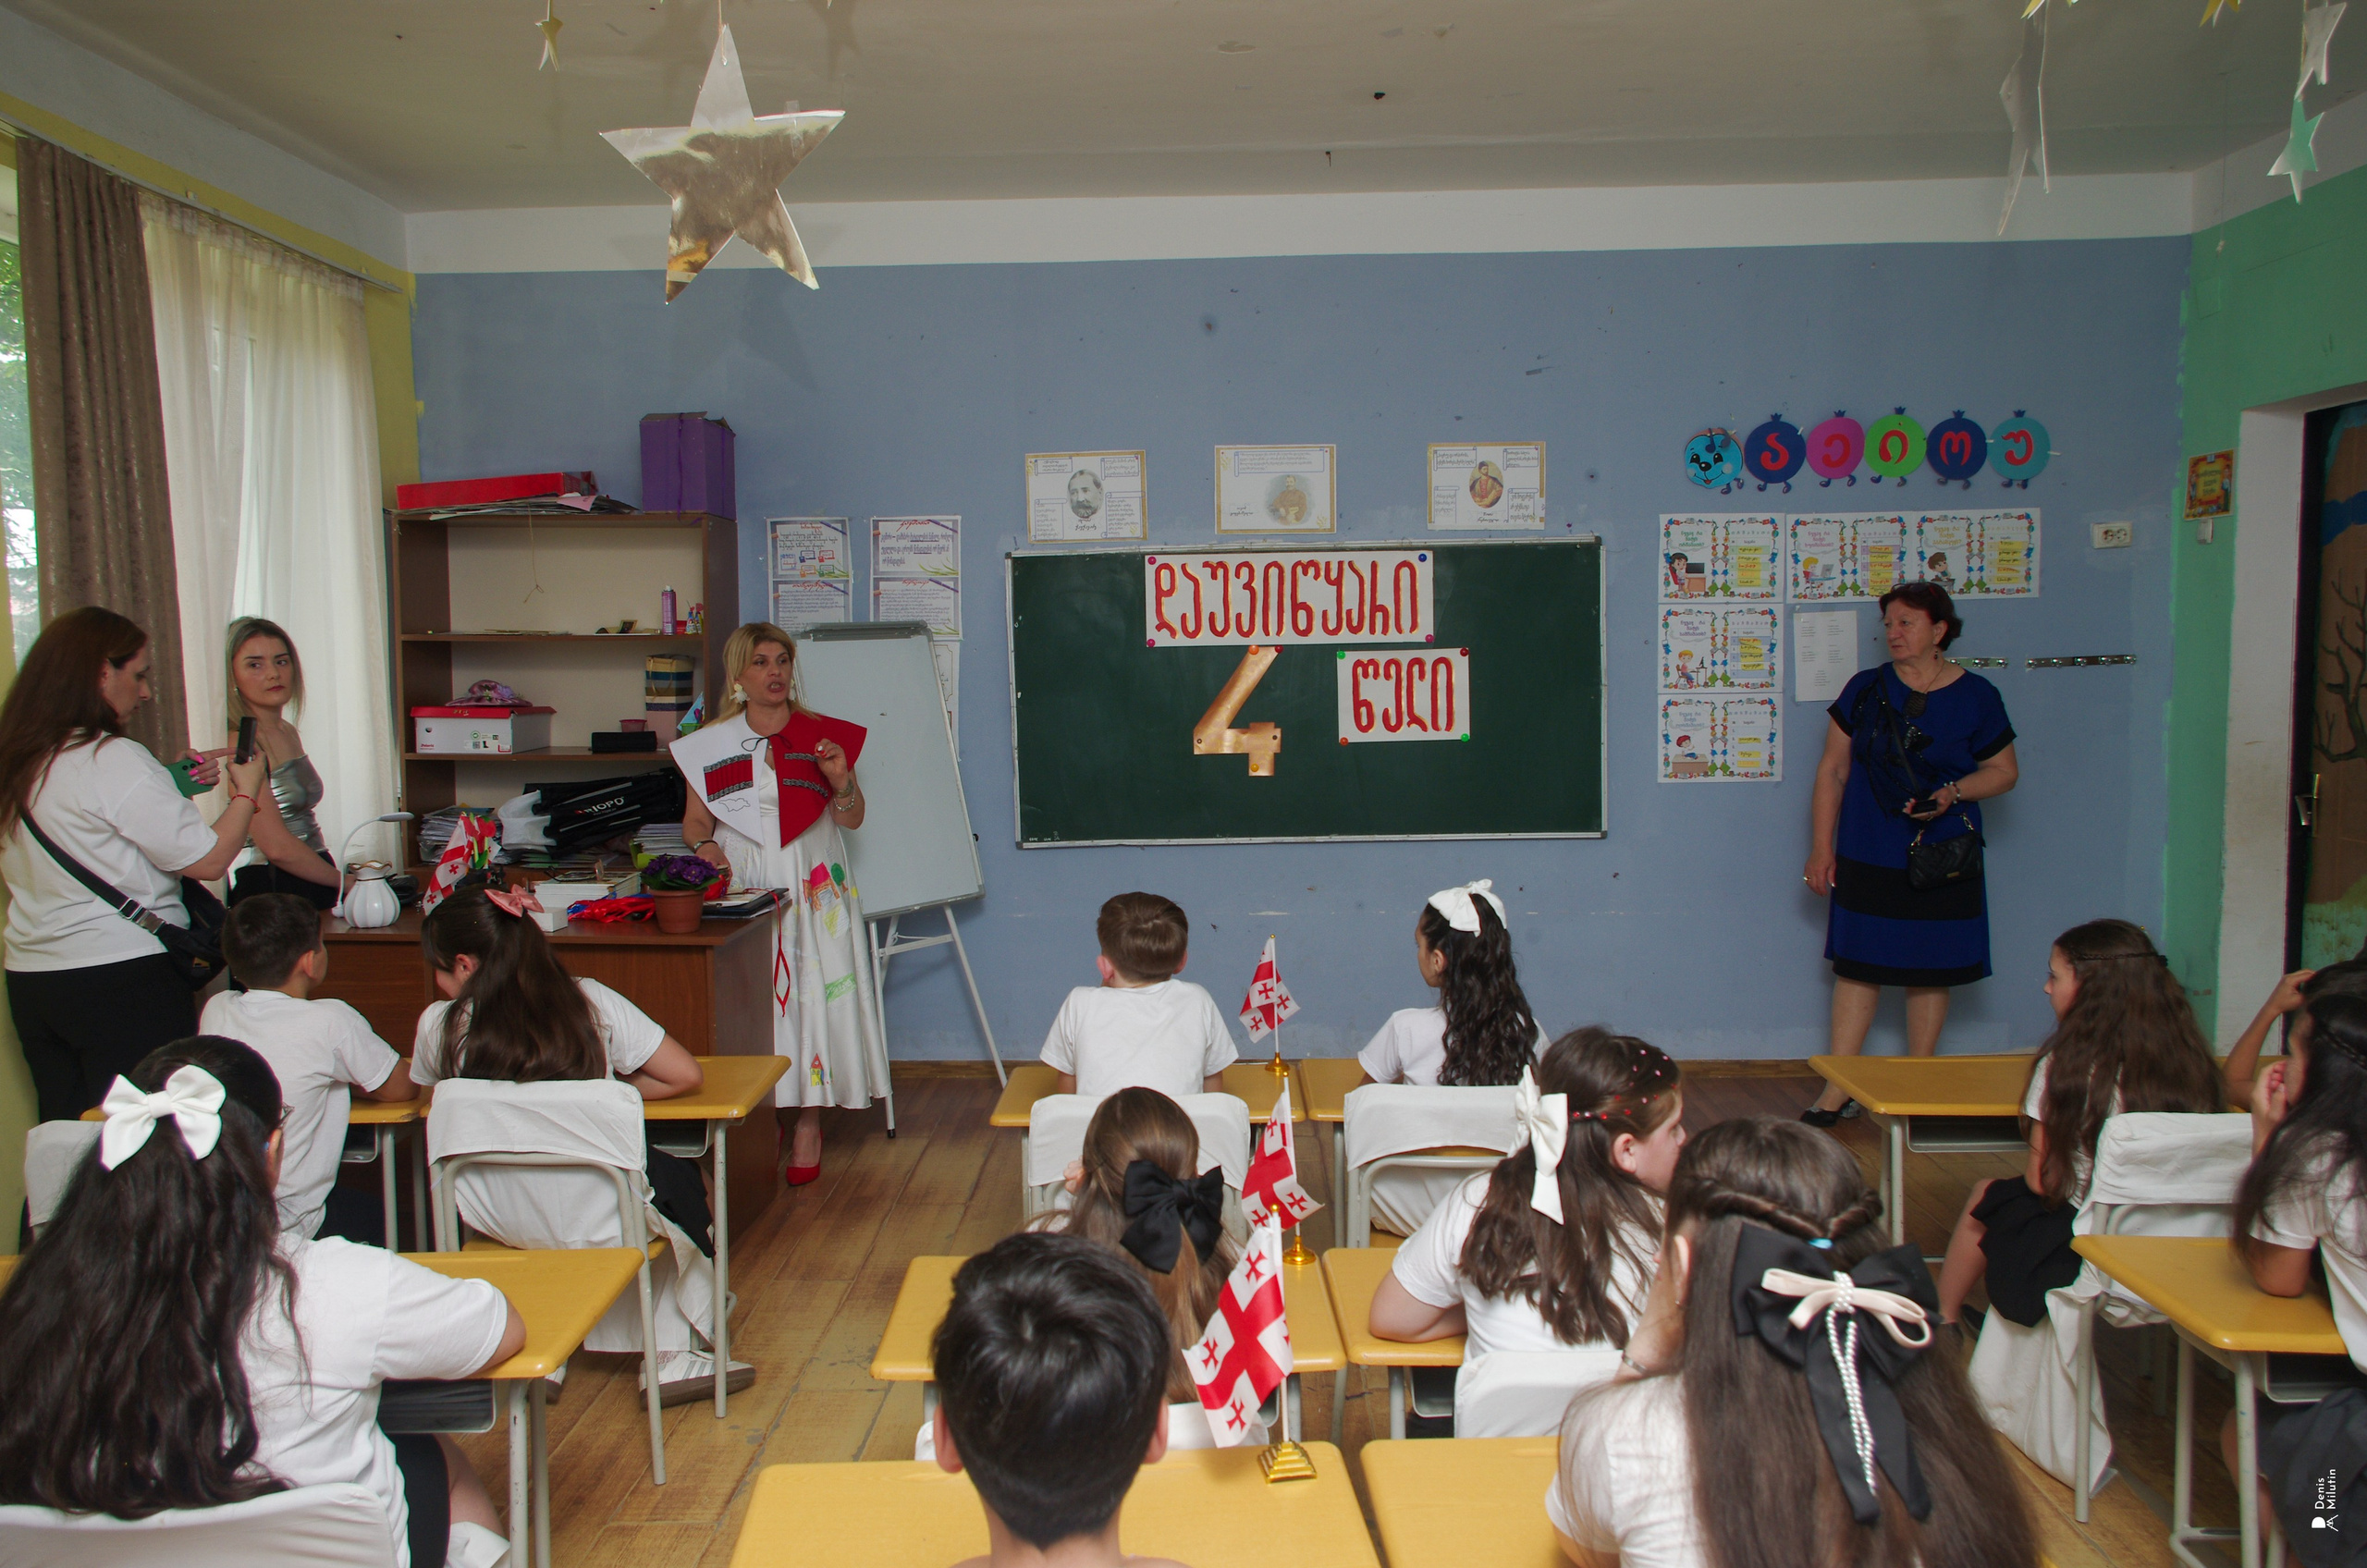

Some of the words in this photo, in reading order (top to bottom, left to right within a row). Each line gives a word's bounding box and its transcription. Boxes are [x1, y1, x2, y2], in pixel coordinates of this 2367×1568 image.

[1760, 433, 1789, 470] ა
[1821, 433, 1850, 468] ე
[1878, 429, 1909, 465] ი
[1939, 430, 1971, 466] ო
[2001, 429, 2033, 467] უ
[1154, 558, 1422, 640] დაუვიწყარი
[1193, 644, 1282, 777] 4
[1352, 655, 1457, 734] წელი
